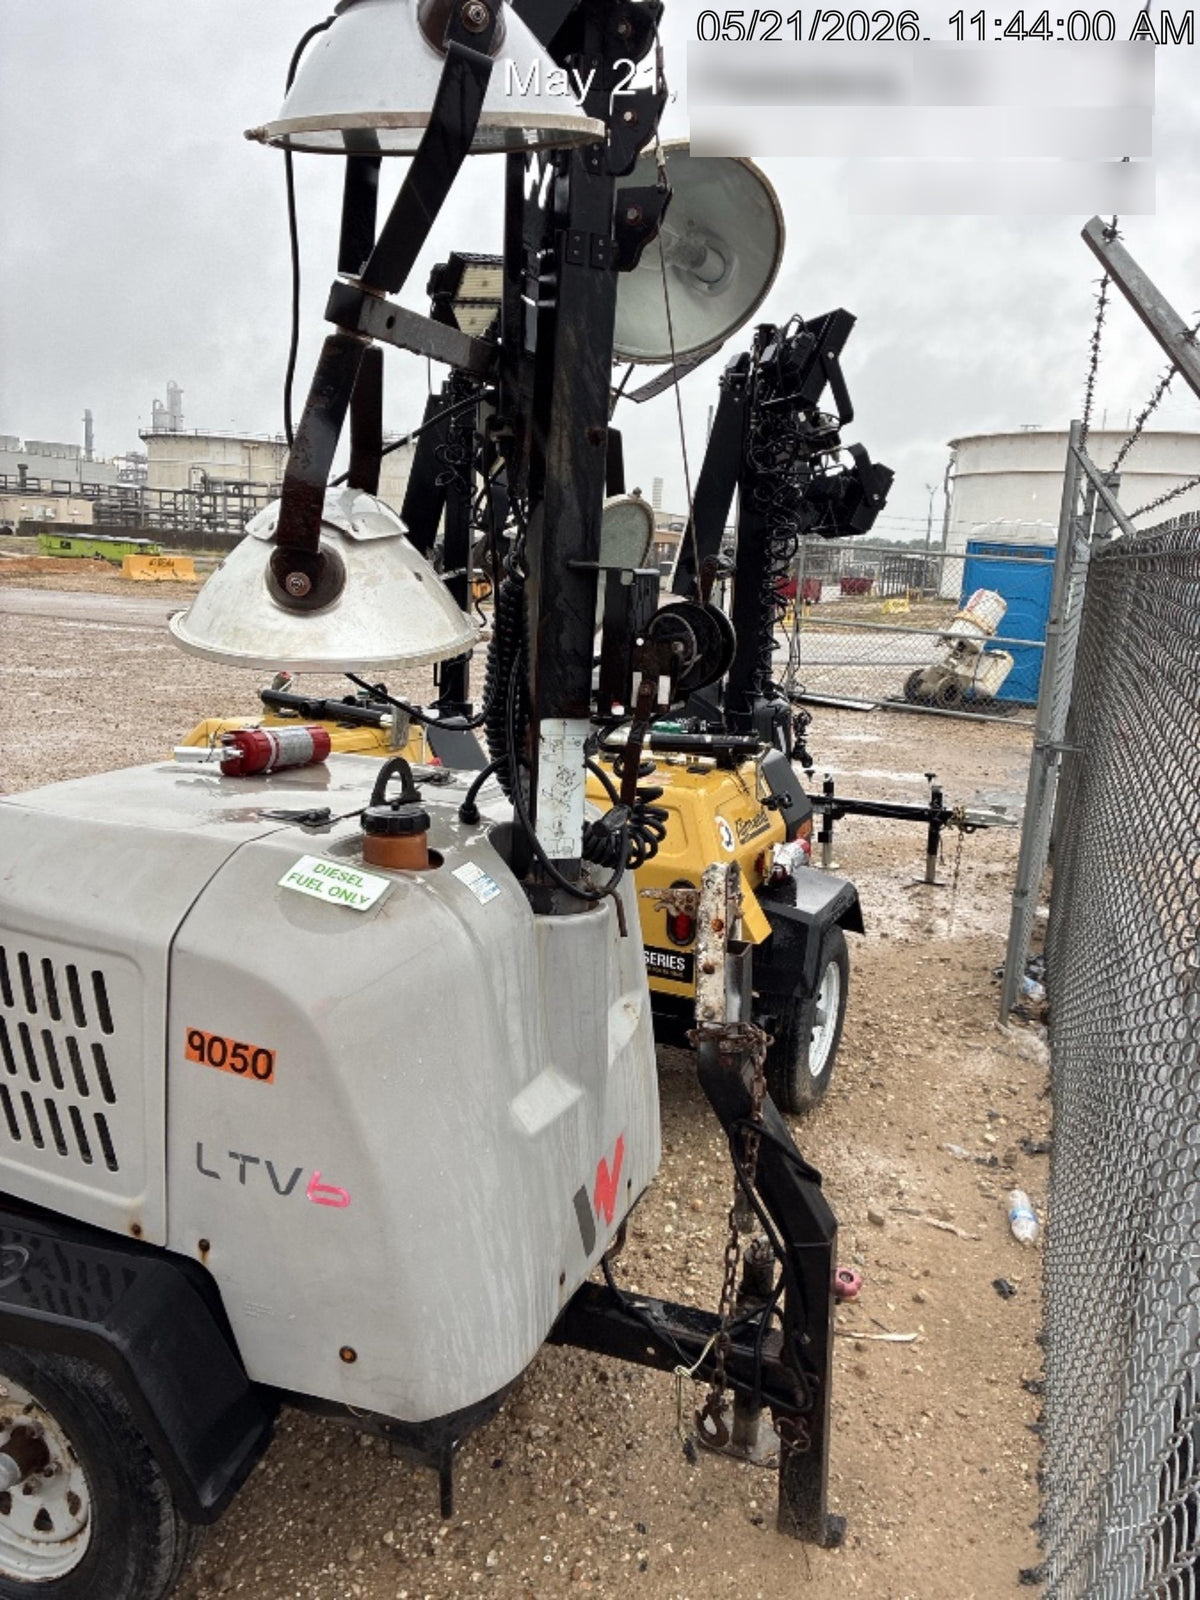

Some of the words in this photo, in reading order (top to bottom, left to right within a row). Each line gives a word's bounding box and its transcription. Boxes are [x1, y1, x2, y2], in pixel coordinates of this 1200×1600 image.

[286, 871, 324, 894] FUEL
[327, 884, 372, 906] ONLY
[311, 862, 365, 889] DIESEL
[643, 950, 686, 972] SERIES
[187, 1029, 274, 1081] 9050
